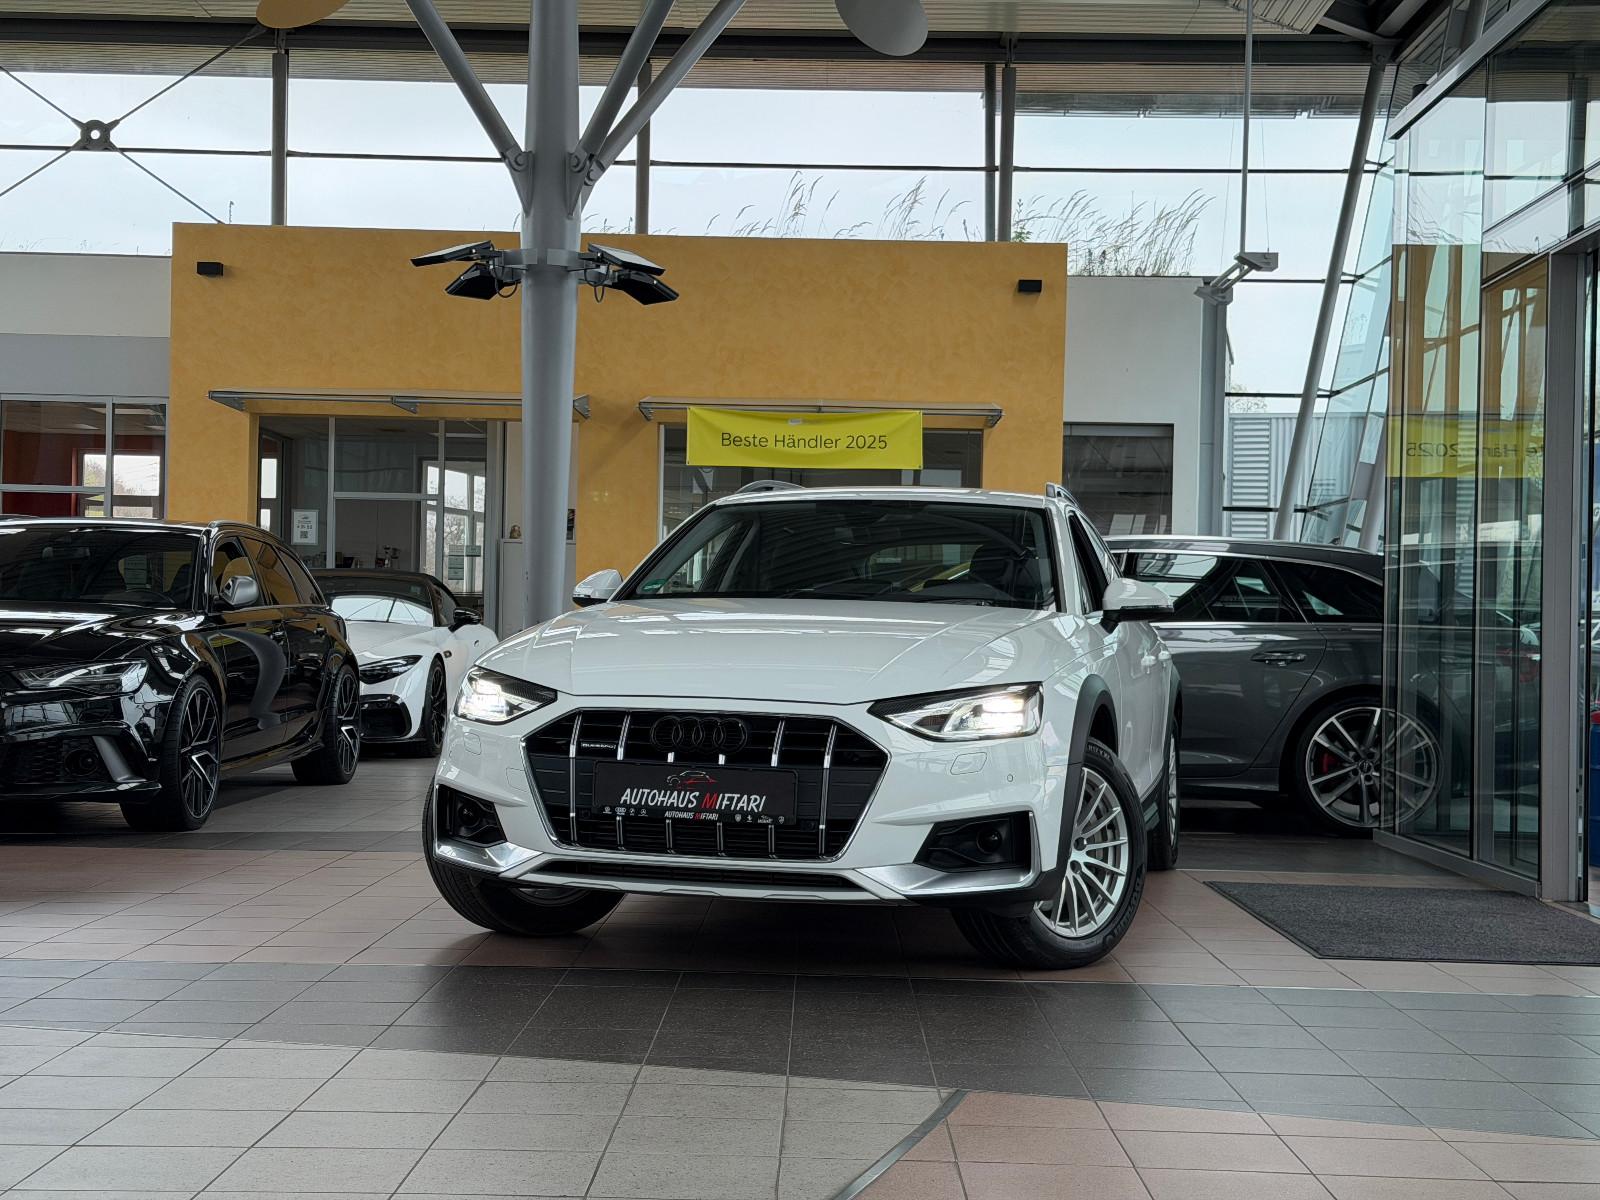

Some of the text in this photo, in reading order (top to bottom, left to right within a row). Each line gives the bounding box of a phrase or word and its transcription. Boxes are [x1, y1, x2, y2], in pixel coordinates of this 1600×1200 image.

[720, 432, 888, 450] Beste Händler 2025
[619, 788, 767, 813] AUTOHAUS MIFTARI
[664, 810, 694, 819] AUTOHAUS
